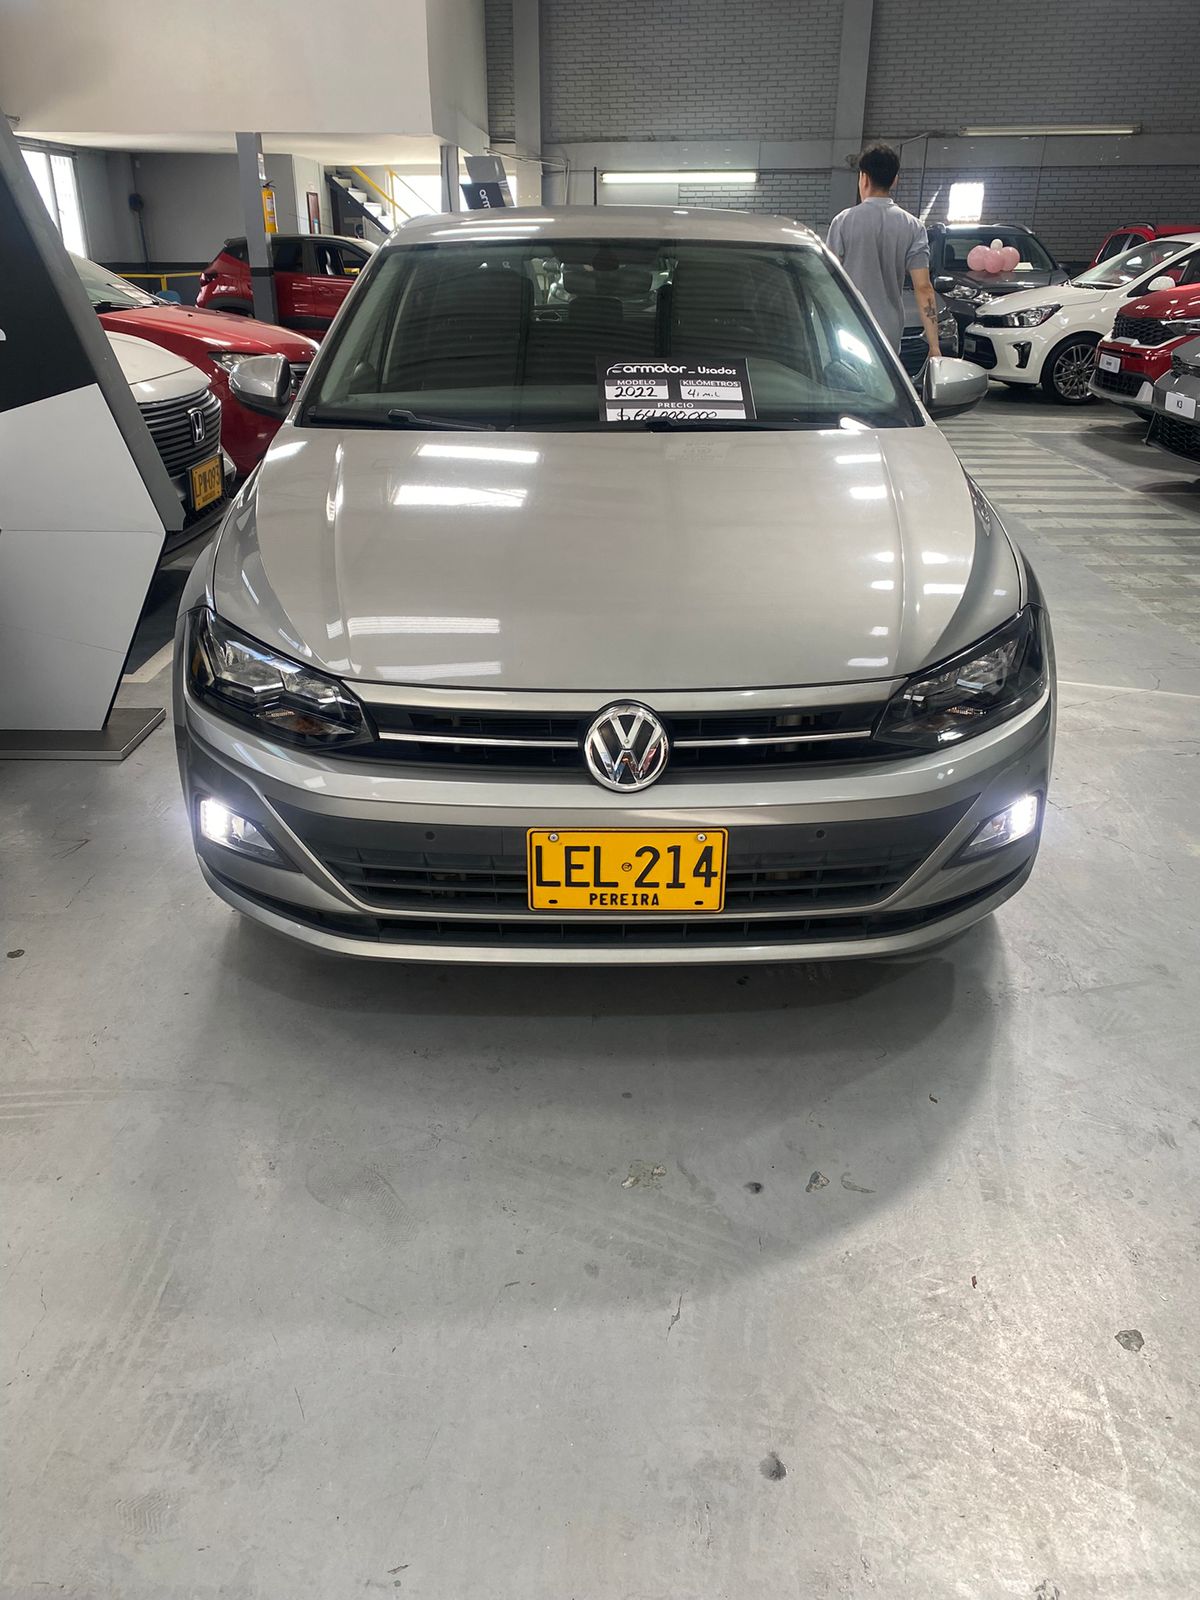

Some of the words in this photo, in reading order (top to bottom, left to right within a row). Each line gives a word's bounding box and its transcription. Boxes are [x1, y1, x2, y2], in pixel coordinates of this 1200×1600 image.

[698, 366, 737, 375] Usados
[682, 379, 740, 387] KILÓMETROS
[614, 386, 658, 398] 2022
[535, 845, 619, 888] LEL
[634, 844, 718, 888] 214
[589, 892, 660, 906] PEREIRA
